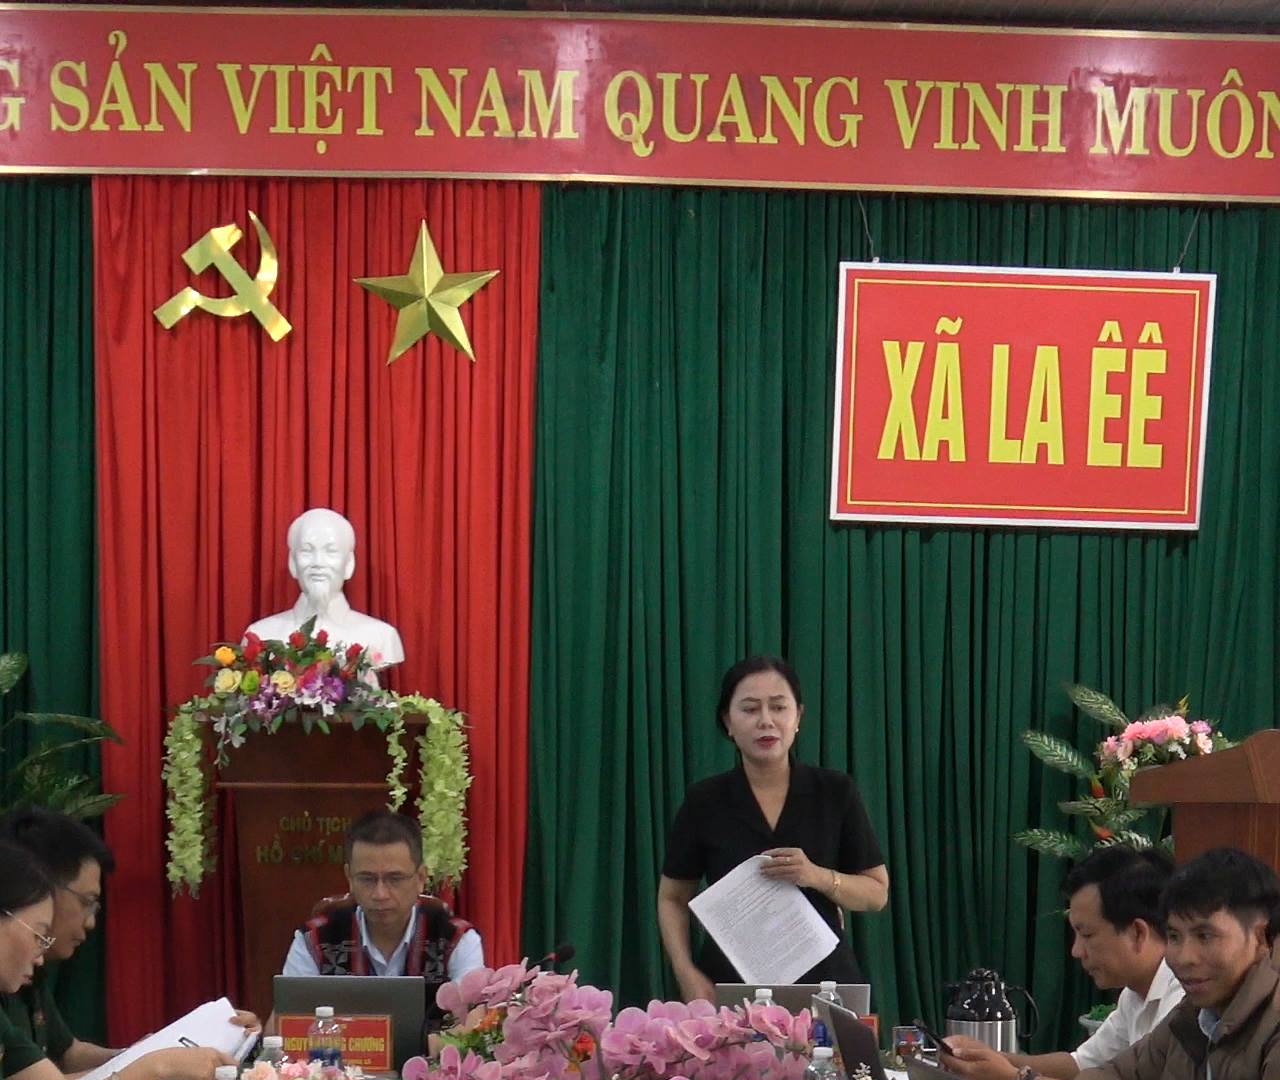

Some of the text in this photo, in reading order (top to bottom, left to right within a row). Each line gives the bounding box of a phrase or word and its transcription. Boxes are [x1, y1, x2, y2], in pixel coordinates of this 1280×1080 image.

[50, 31, 196, 134] SẢN
[216, 43, 393, 154] VIỆT
[415, 67, 578, 139] NAM
[604, 70, 864, 158] QUANG
[884, 78, 1065, 154] VINH
[877, 317, 1169, 470] XÃ LA ÊÊ
